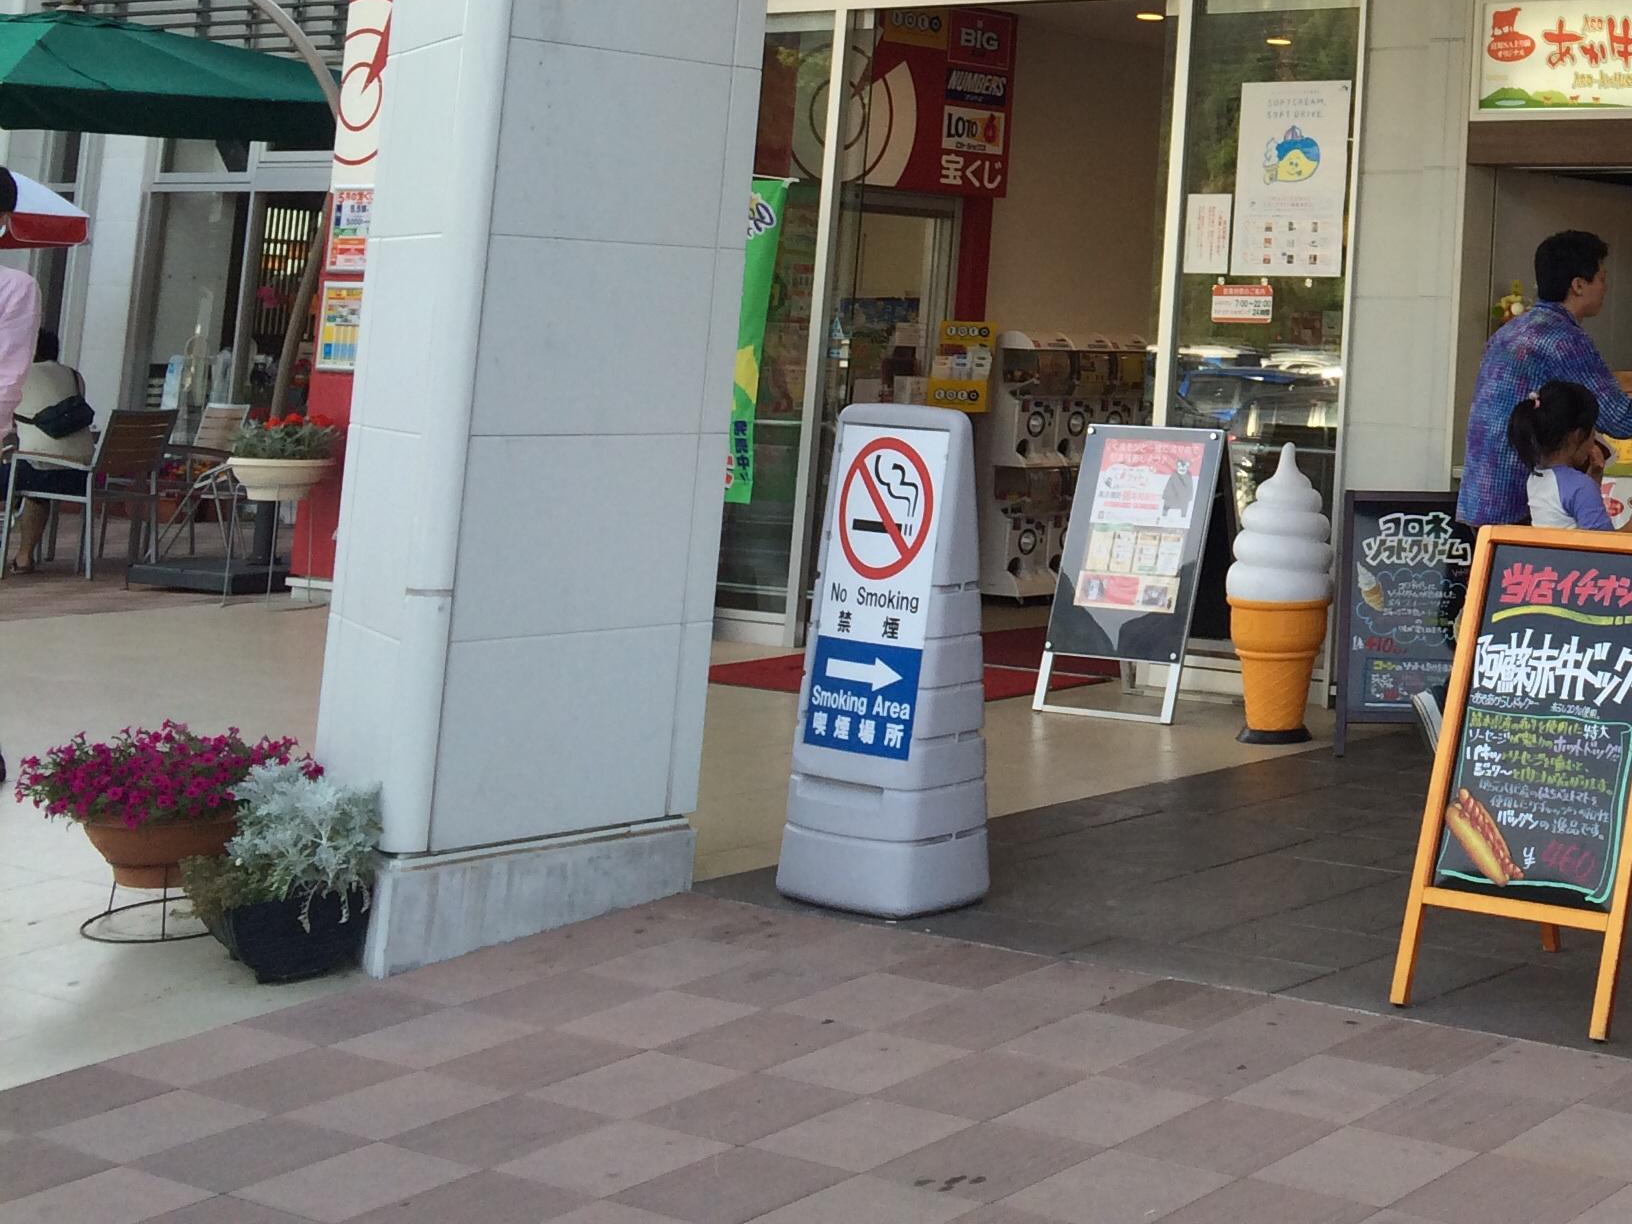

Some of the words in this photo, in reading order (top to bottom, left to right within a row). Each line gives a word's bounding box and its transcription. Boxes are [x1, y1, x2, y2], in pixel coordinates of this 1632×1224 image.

[960, 28, 998, 51] BIG
[948, 70, 1006, 96] NUMBERS
[946, 113, 979, 138] LOTO
[940, 154, 1002, 189] 宝くじ
[1379, 512, 1453, 539] コロネ
[1362, 535, 1471, 567] ソフトクリーム
[830, 582, 849, 603] No
[857, 586, 920, 614] Smoking
[836, 609, 902, 640] 禁煙
[811, 684, 868, 716] Smoking
[873, 696, 911, 721] Area
[812, 711, 904, 749] 喫煙場所
